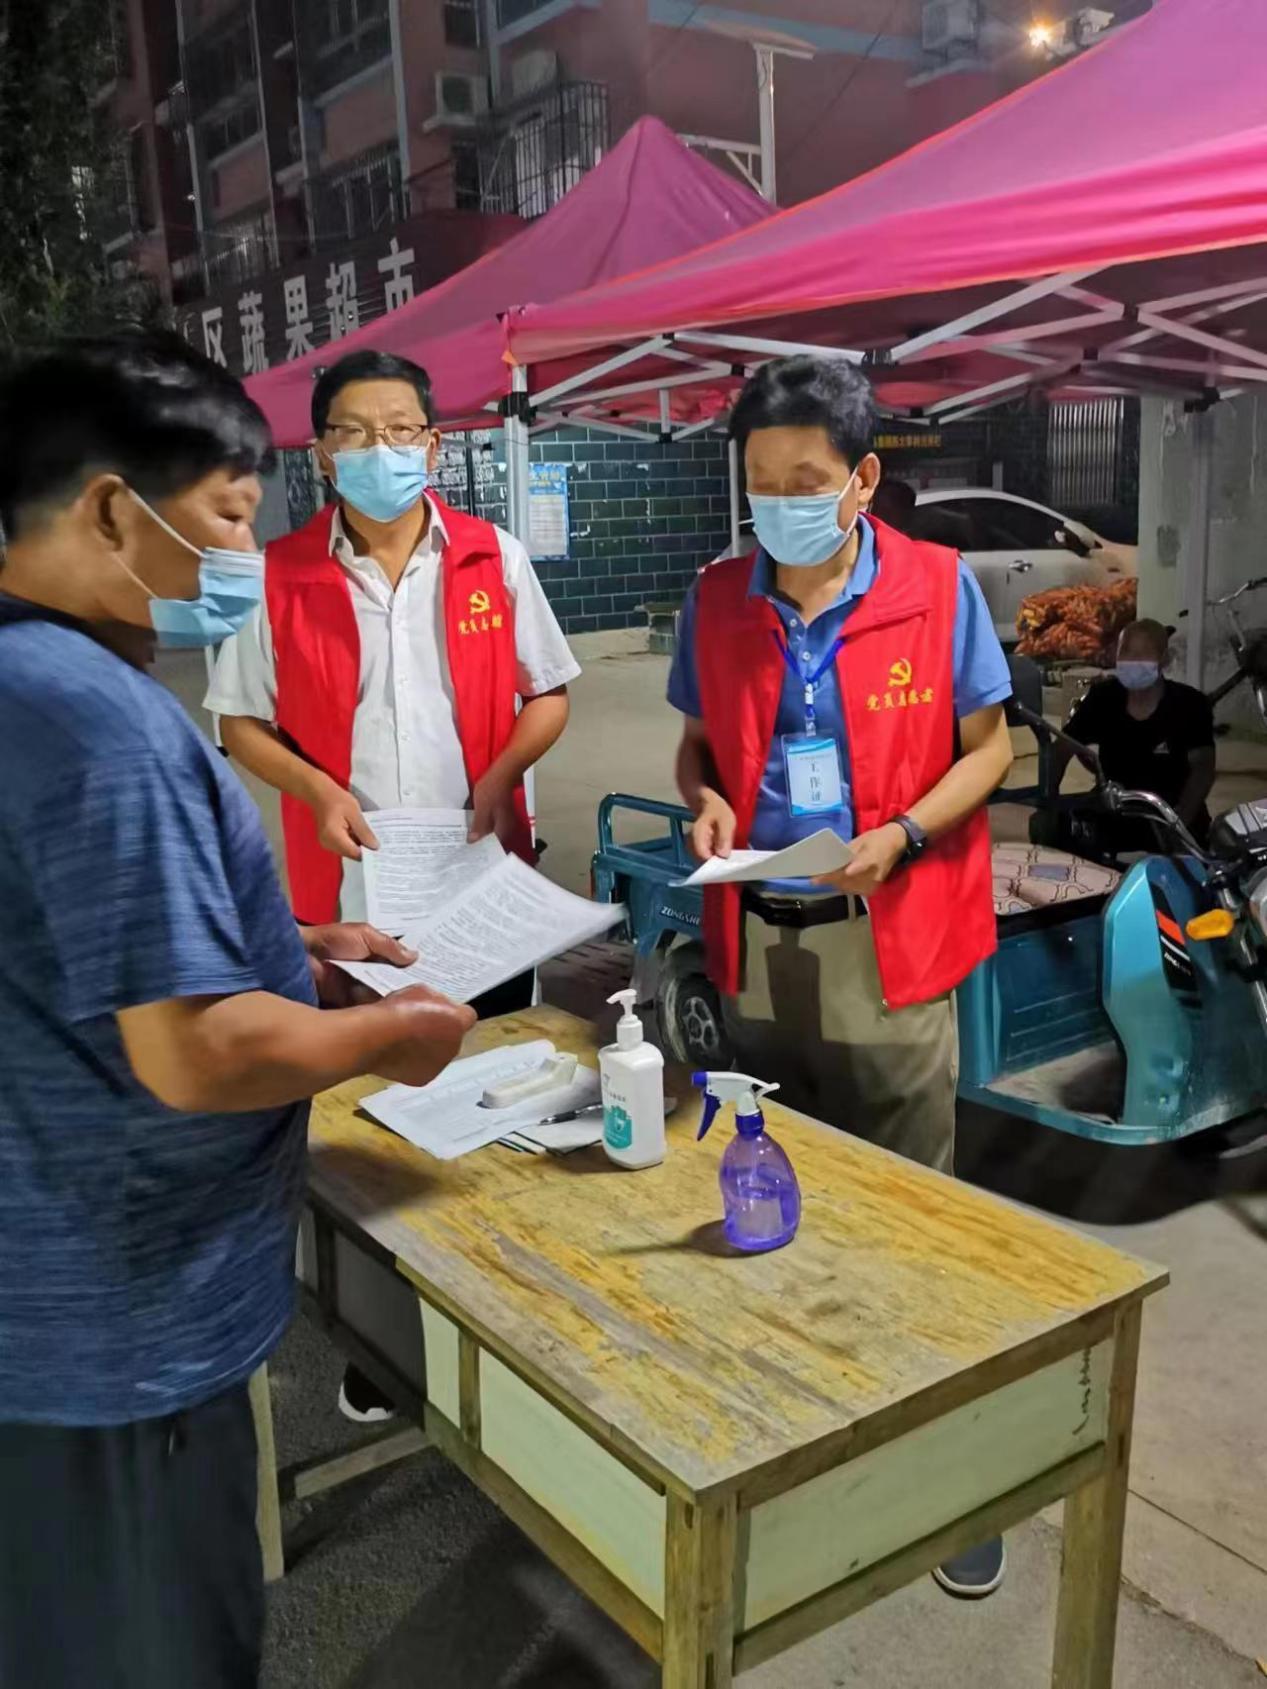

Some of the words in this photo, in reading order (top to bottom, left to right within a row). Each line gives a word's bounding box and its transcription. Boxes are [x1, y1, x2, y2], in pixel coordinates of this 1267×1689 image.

[183, 237, 415, 375] 区蔬果超市
